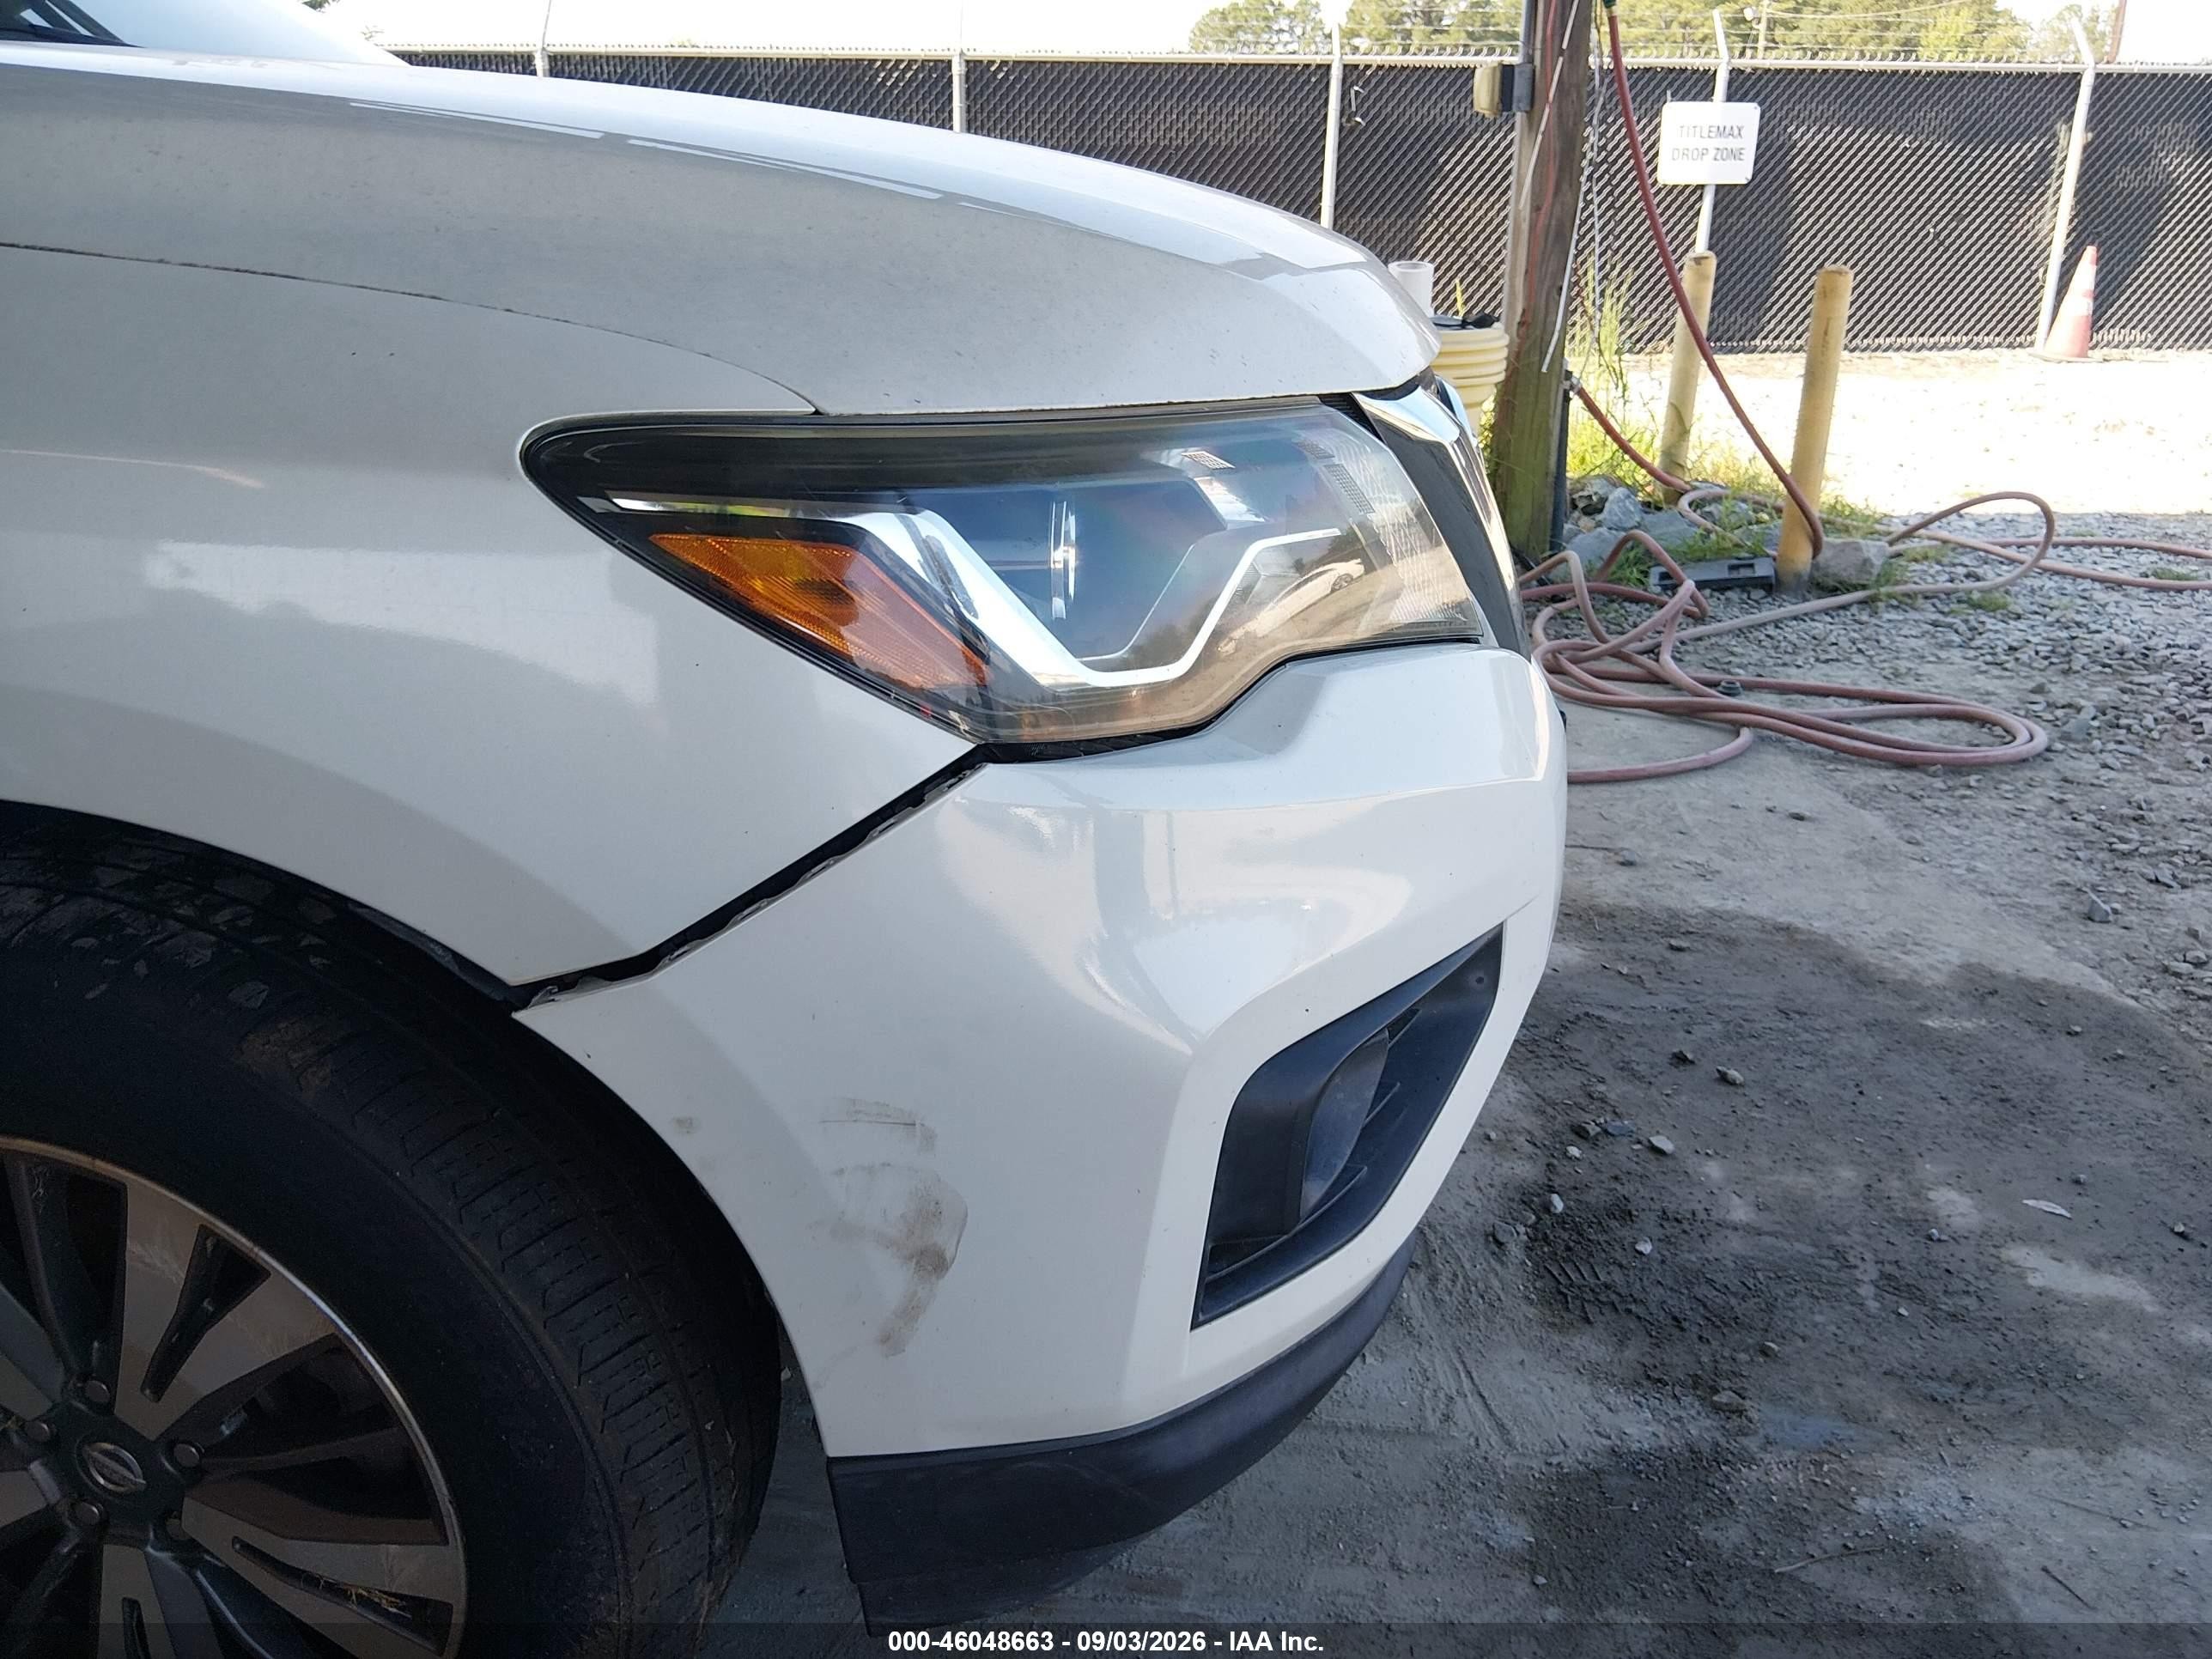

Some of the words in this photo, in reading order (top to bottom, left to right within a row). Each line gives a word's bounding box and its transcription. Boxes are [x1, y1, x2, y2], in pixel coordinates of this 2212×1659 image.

[1680, 125, 1745, 139] TITLEMAX
[1671, 147, 1709, 161] DROP
[1713, 147, 1746, 161] ZONE
